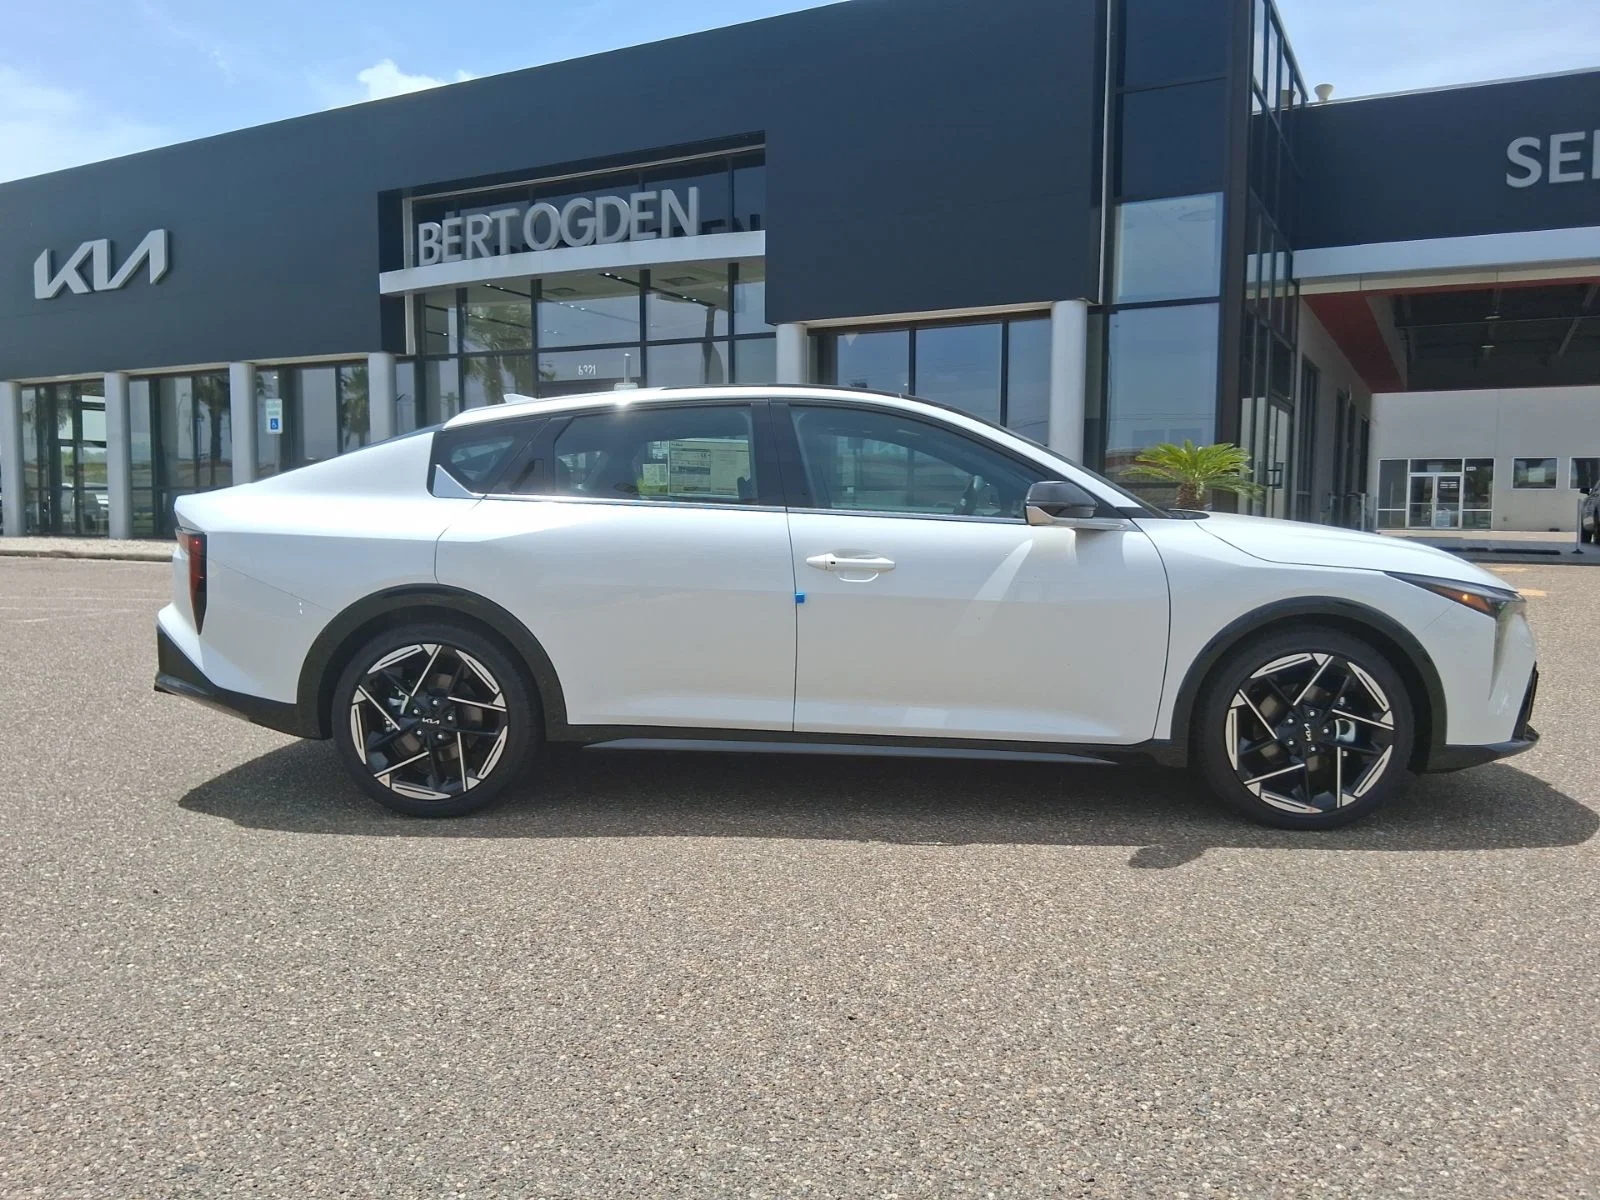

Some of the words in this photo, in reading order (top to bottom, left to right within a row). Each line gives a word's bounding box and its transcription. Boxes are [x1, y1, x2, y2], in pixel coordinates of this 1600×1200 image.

[1506, 129, 1600, 188] SE
[418, 207, 520, 267] BERT
[523, 186, 699, 251] OGDEN
[34, 228, 168, 299] KIA
